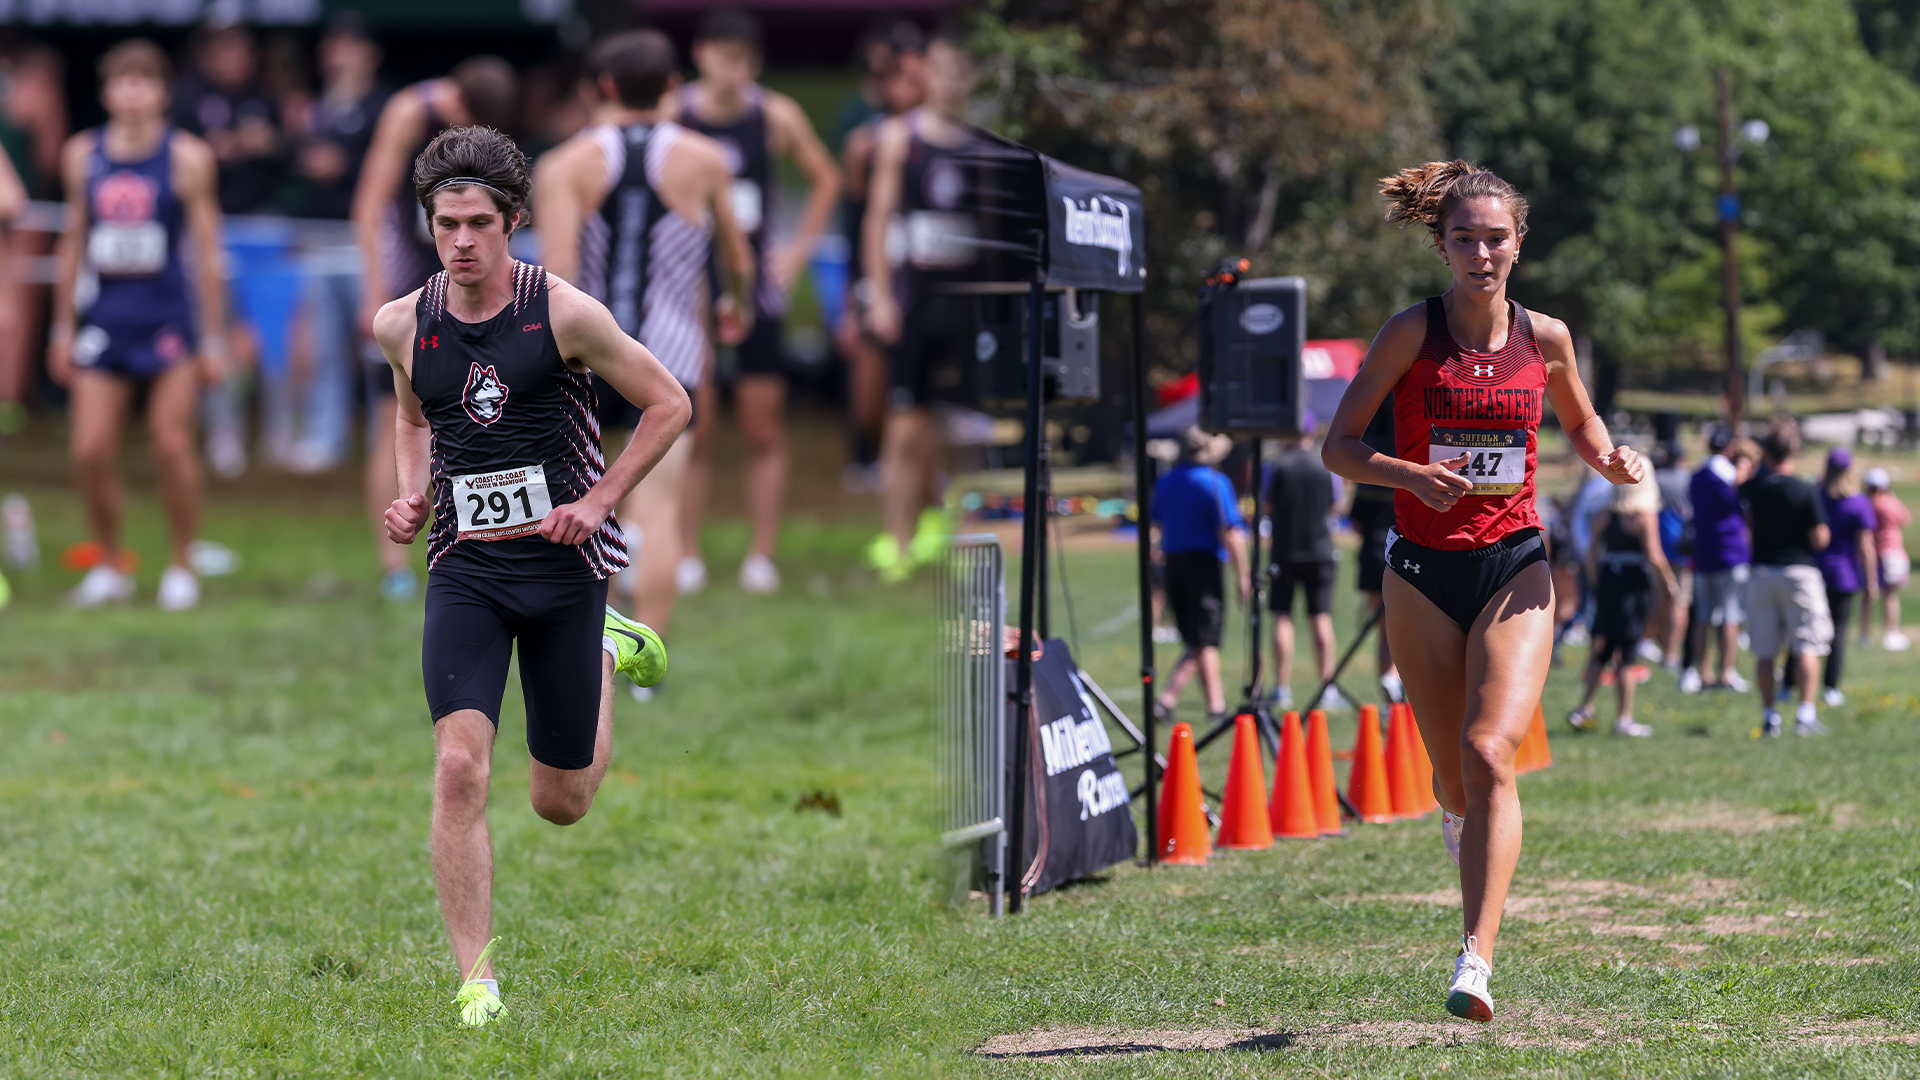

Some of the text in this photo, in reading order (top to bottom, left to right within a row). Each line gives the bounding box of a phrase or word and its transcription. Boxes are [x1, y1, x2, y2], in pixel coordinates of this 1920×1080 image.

[522, 322, 543, 332] CAA
[1423, 387, 1538, 421] NORTHEASTERN
[1460, 433, 1499, 442] SUFFOLK
[475, 470, 526, 484] COAST-TO-COAST
[499, 477, 528, 487] BEANTOWN
[466, 486, 534, 526] 291
